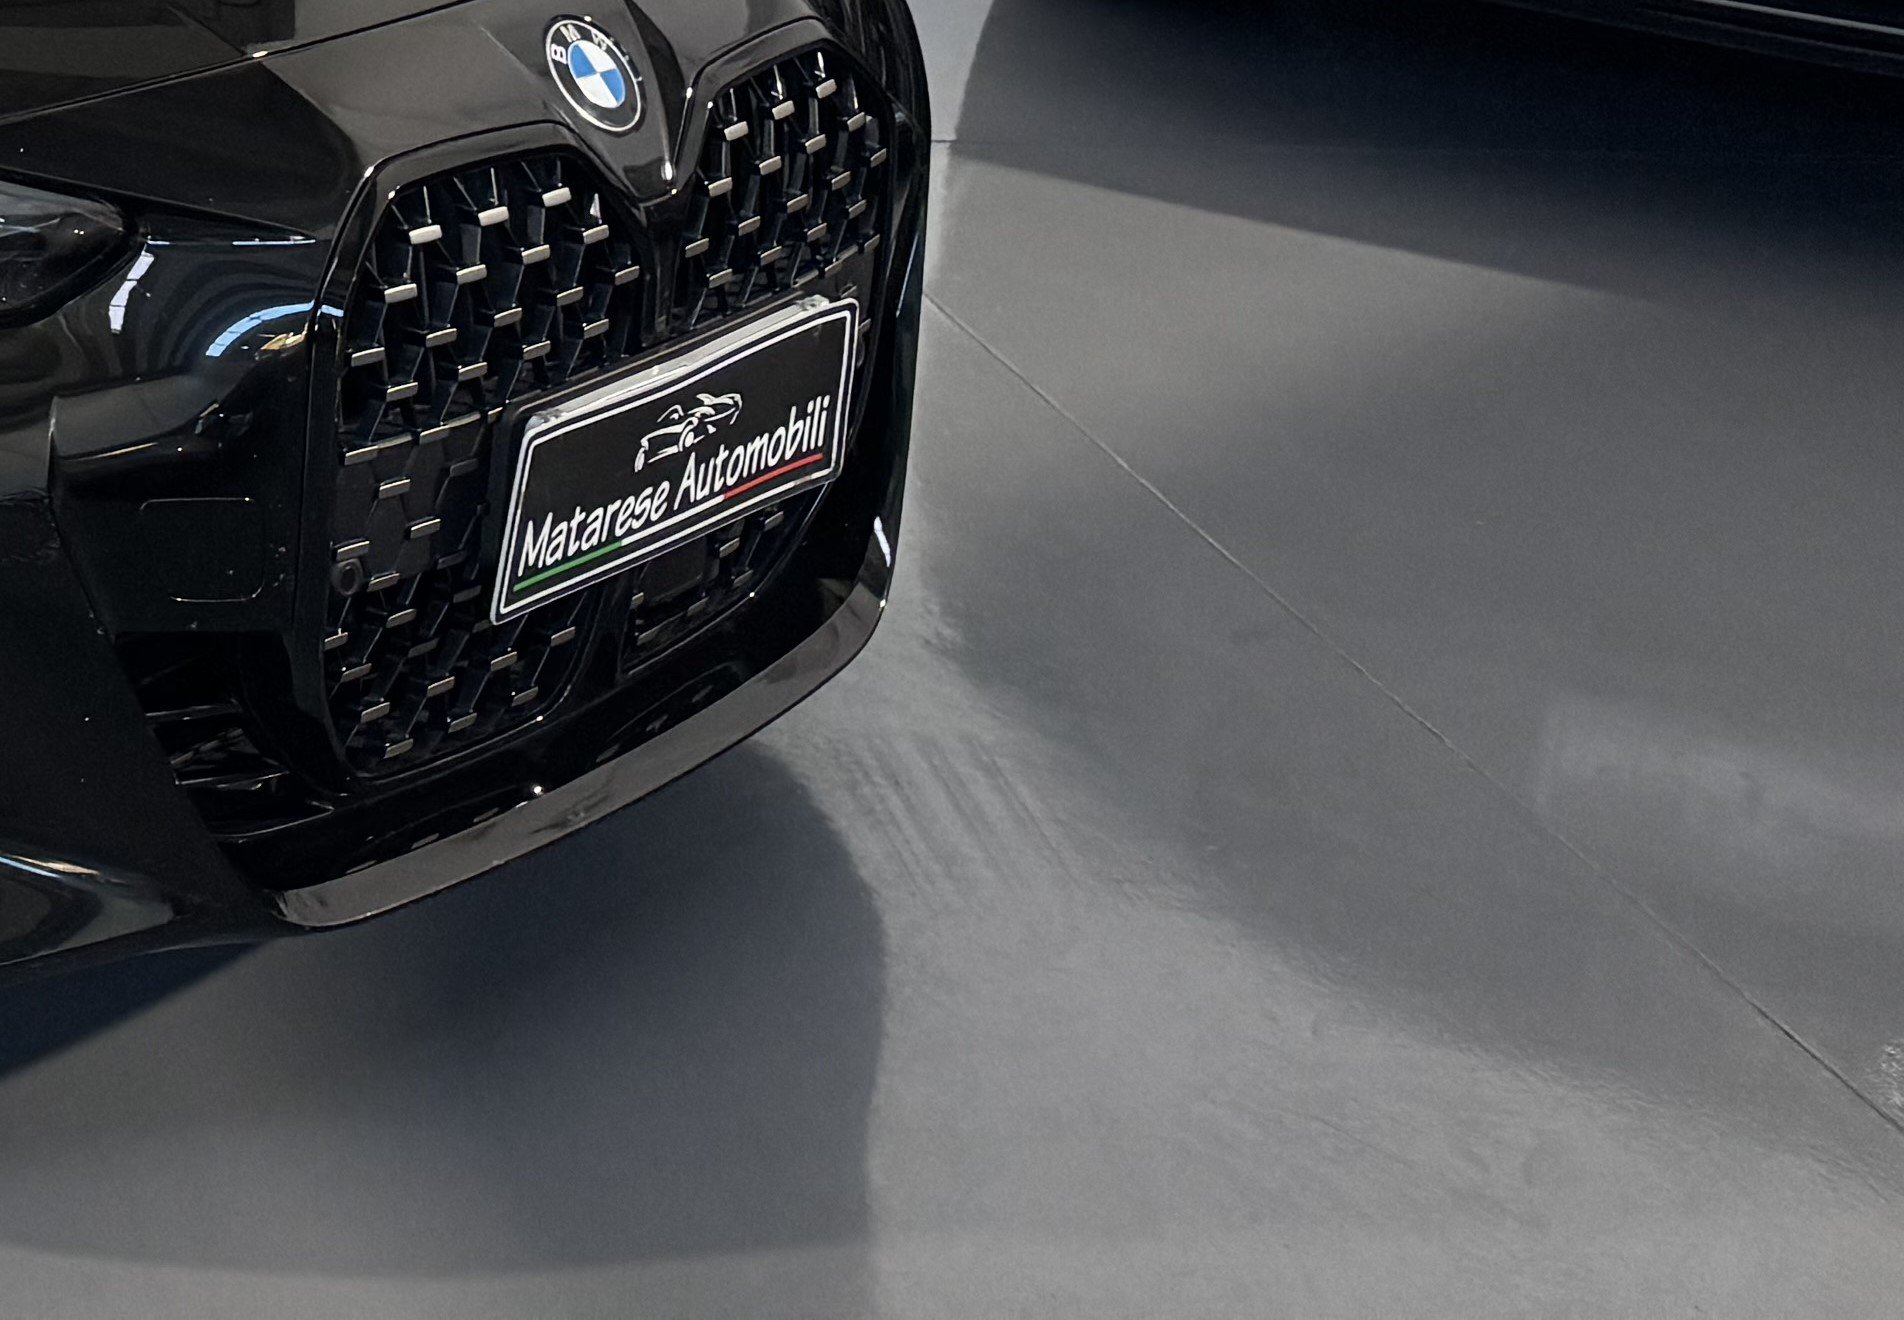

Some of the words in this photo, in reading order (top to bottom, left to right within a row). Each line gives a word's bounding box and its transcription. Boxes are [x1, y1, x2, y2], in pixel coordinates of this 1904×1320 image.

[551, 23, 608, 65] BMW
[517, 480, 670, 577] Matarese
[674, 395, 831, 510] Automobili
